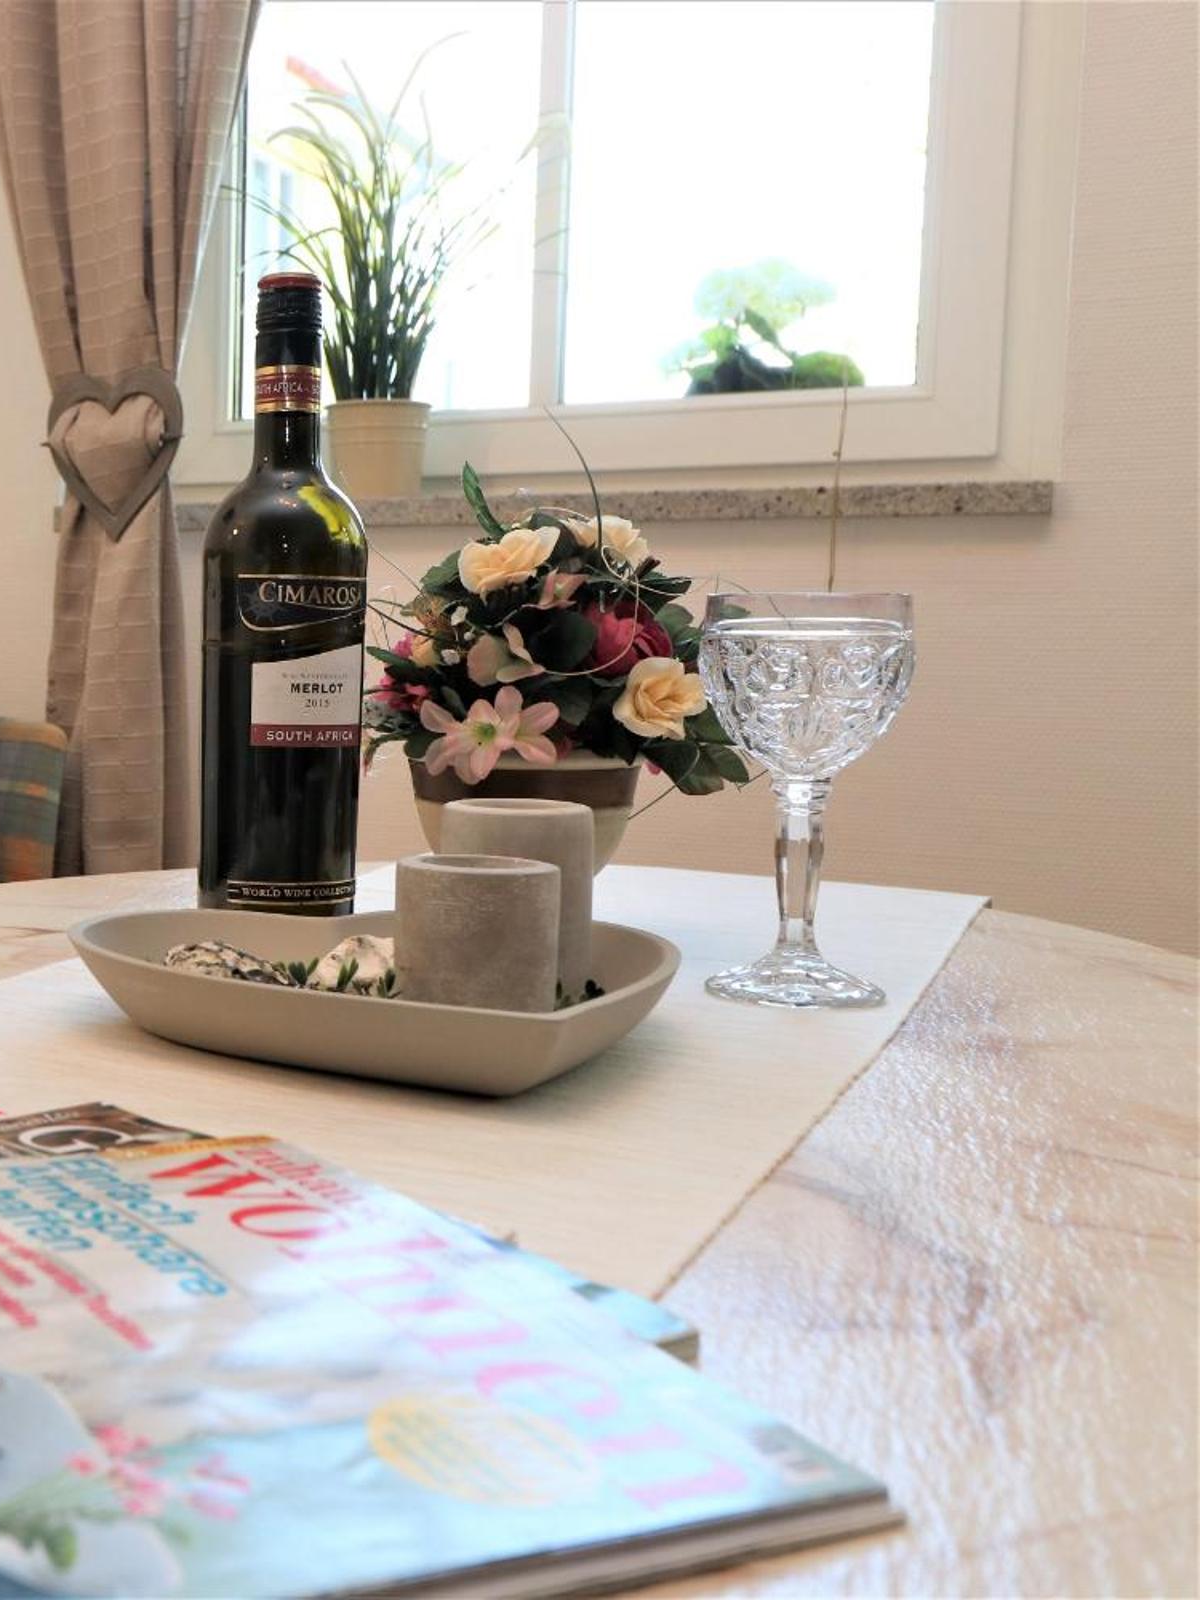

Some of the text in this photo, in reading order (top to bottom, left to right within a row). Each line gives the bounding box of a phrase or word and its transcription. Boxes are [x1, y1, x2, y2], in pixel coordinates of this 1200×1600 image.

[273, 382, 303, 393] AFRICA
[290, 682, 343, 694] MERLOT
[266, 730, 353, 741] SOUTH AFRICA
[241, 886, 280, 897] WORLD
[283, 888, 311, 897] WINE
